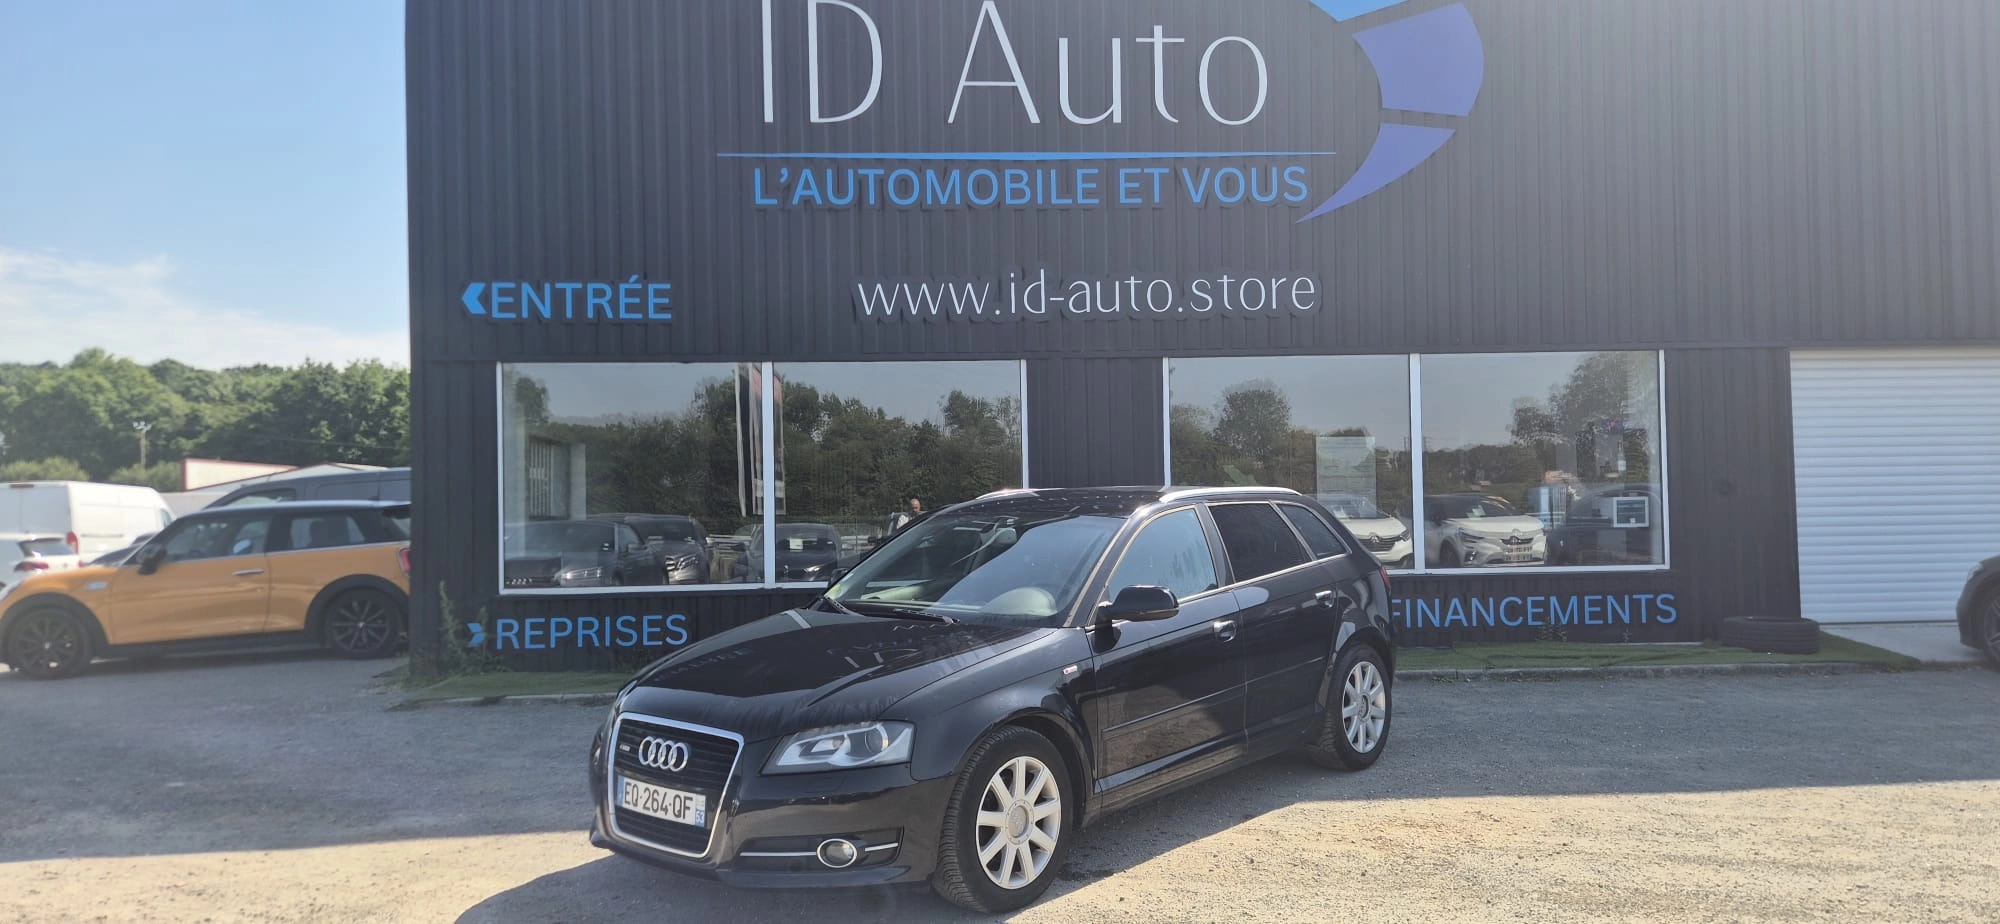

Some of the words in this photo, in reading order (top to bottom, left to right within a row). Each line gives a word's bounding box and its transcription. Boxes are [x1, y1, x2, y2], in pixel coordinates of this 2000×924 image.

[761, 0, 883, 123] ID
[947, 0, 1268, 125] Auto
[754, 167, 1099, 206] L’AUTOMOBILE
[1119, 167, 1169, 204] ET
[1181, 166, 1308, 203] VOUS
[491, 274, 672, 319] ENTRÉE
[857, 268, 1316, 316] www.id-auto.store
[496, 614, 688, 649] REPRISES
